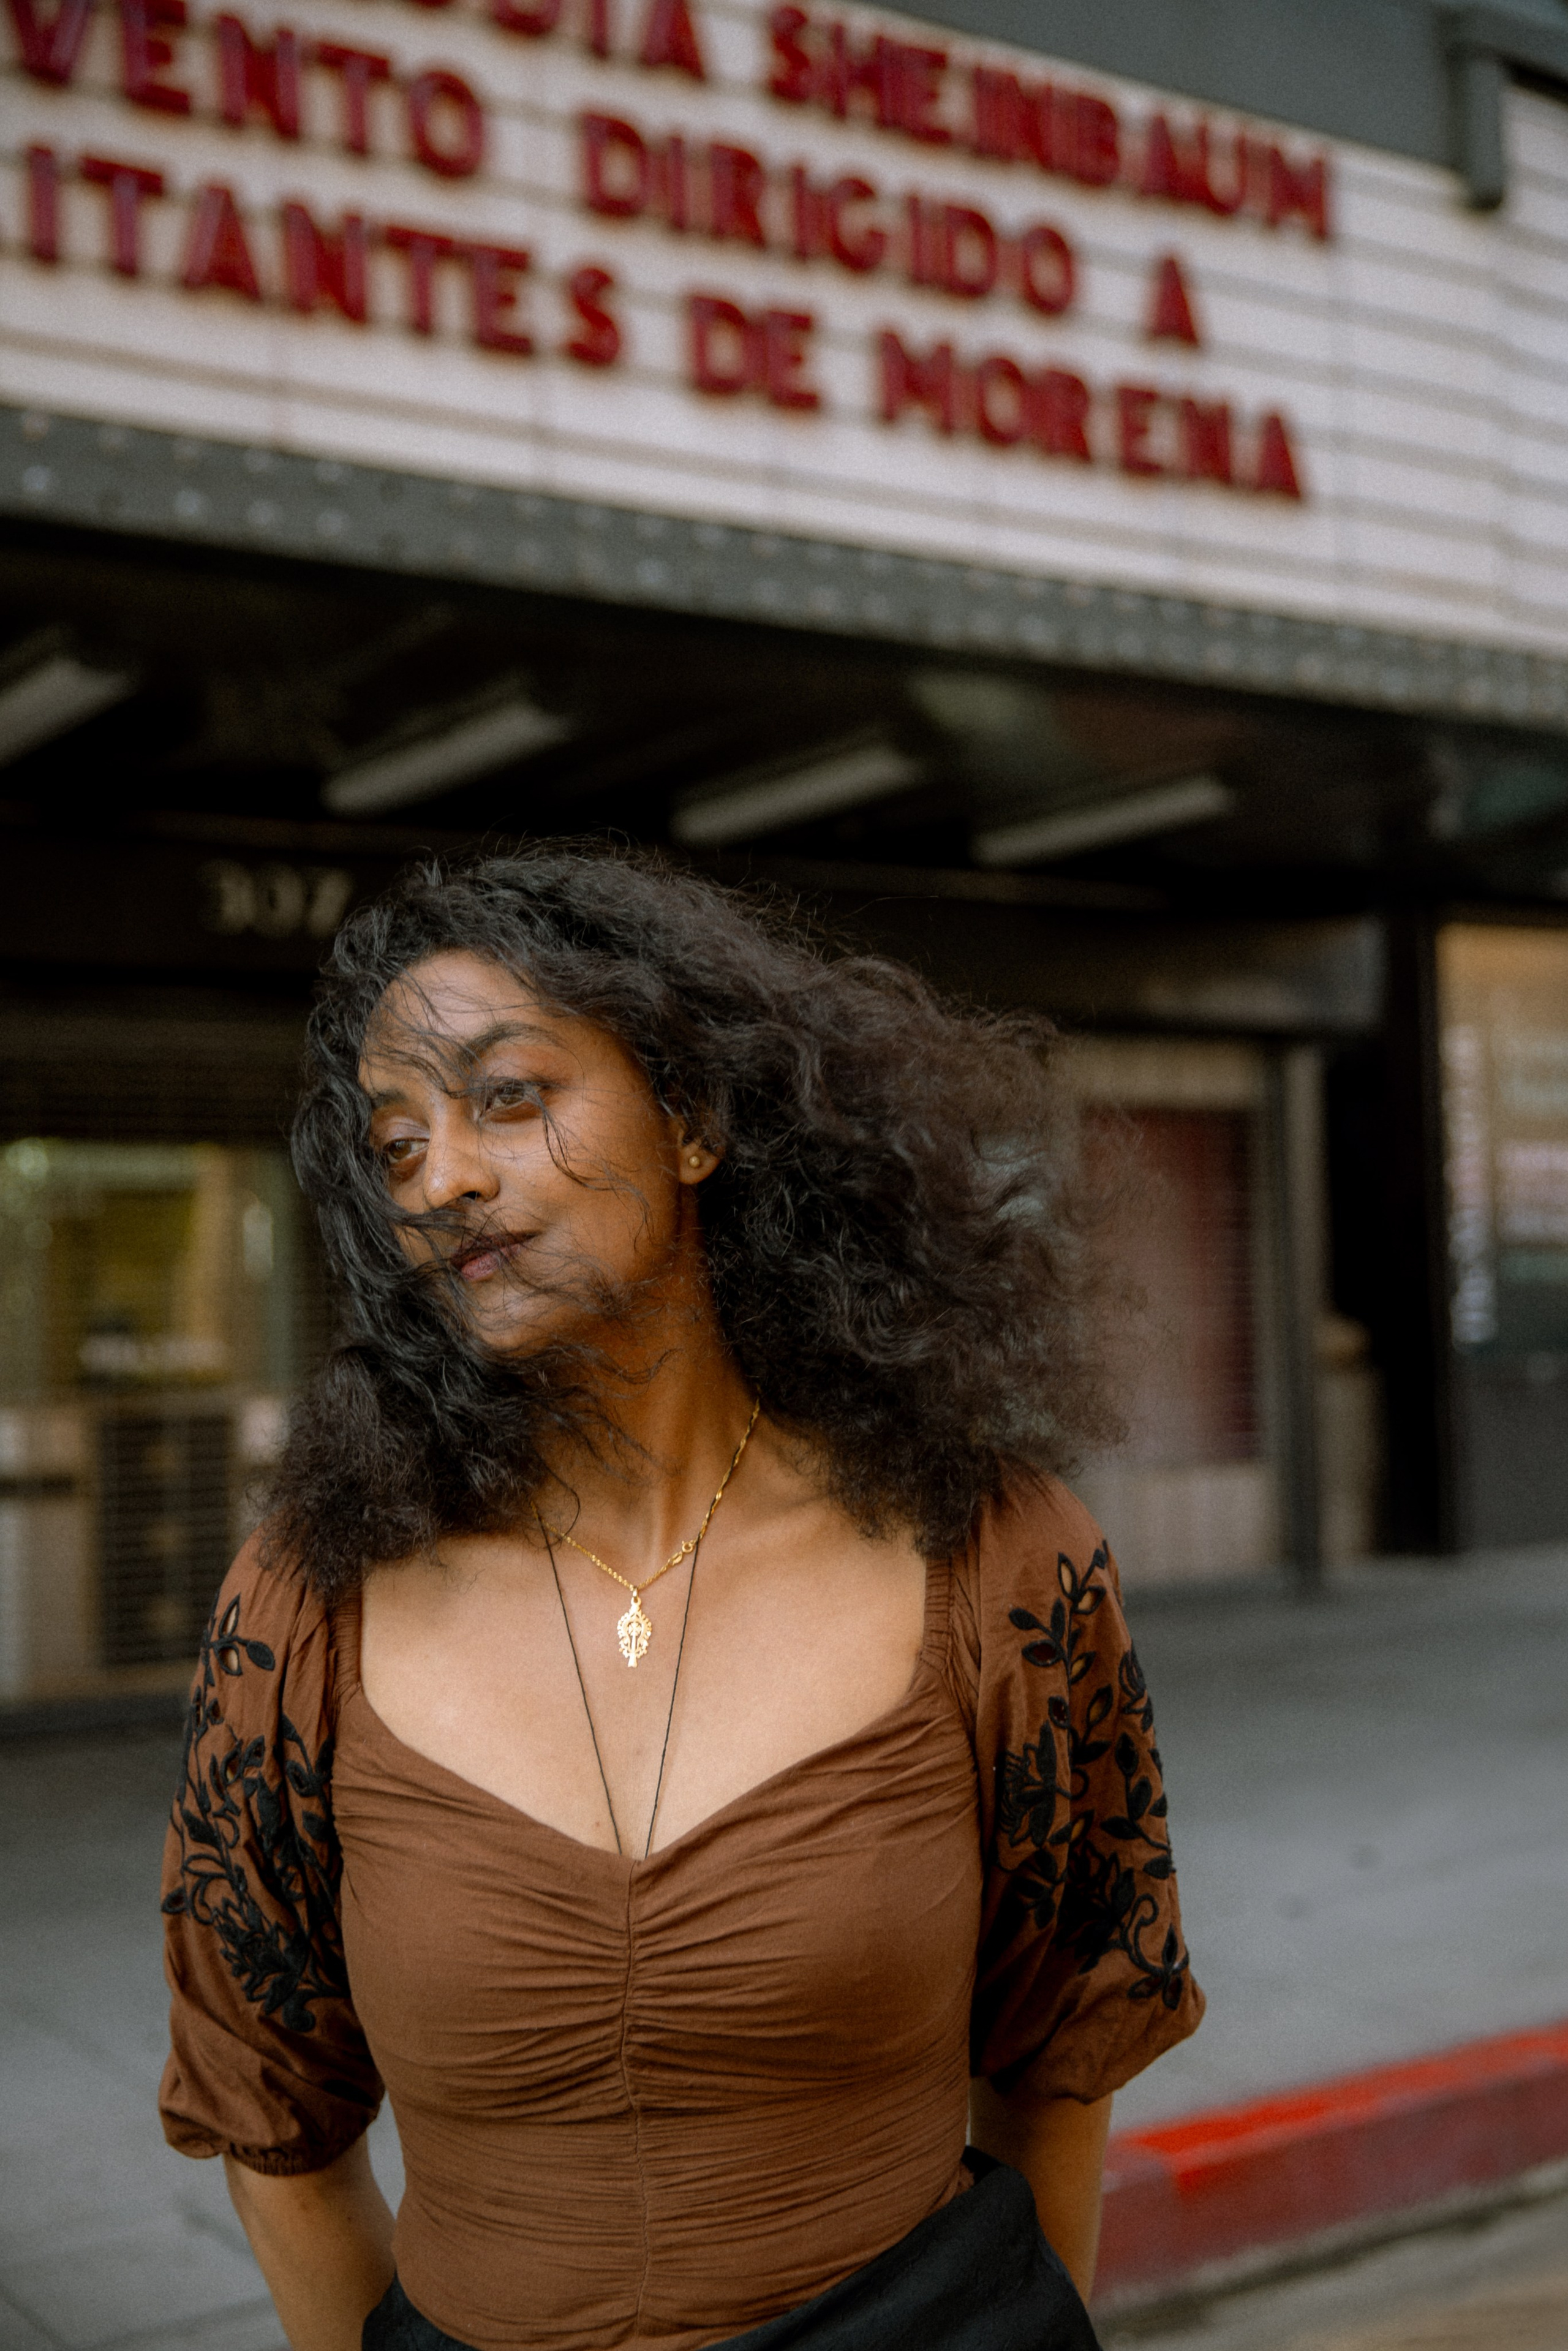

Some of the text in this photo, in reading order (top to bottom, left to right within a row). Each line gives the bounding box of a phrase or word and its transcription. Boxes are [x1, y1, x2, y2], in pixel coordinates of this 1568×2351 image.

[28, 146, 1300, 499] ITANTES DE MORENA
[581, 111, 1077, 316] DIRIGIDO
[1149, 258, 1199, 346] A
